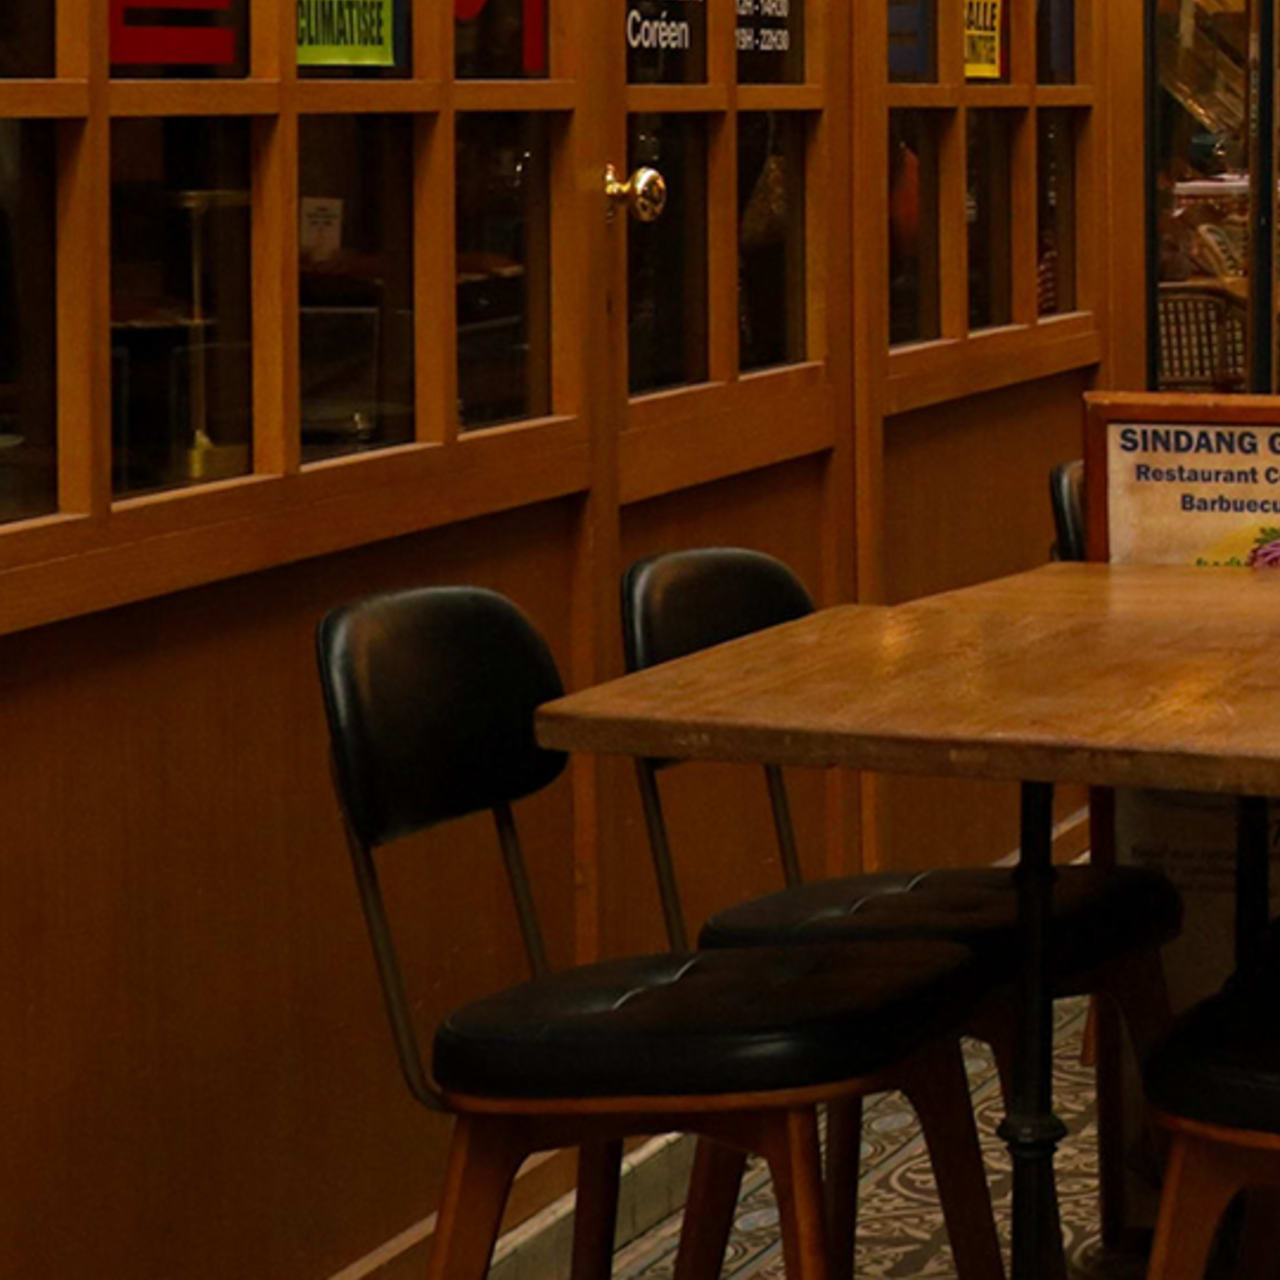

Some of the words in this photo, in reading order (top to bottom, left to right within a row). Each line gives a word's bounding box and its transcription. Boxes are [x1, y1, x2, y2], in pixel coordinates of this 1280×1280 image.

[627, 9, 689, 48] Coréen
[967, 0, 997, 31] ALLE
[1119, 428, 1258, 455] SINDANG
[1135, 464, 1258, 484] Restaurant
